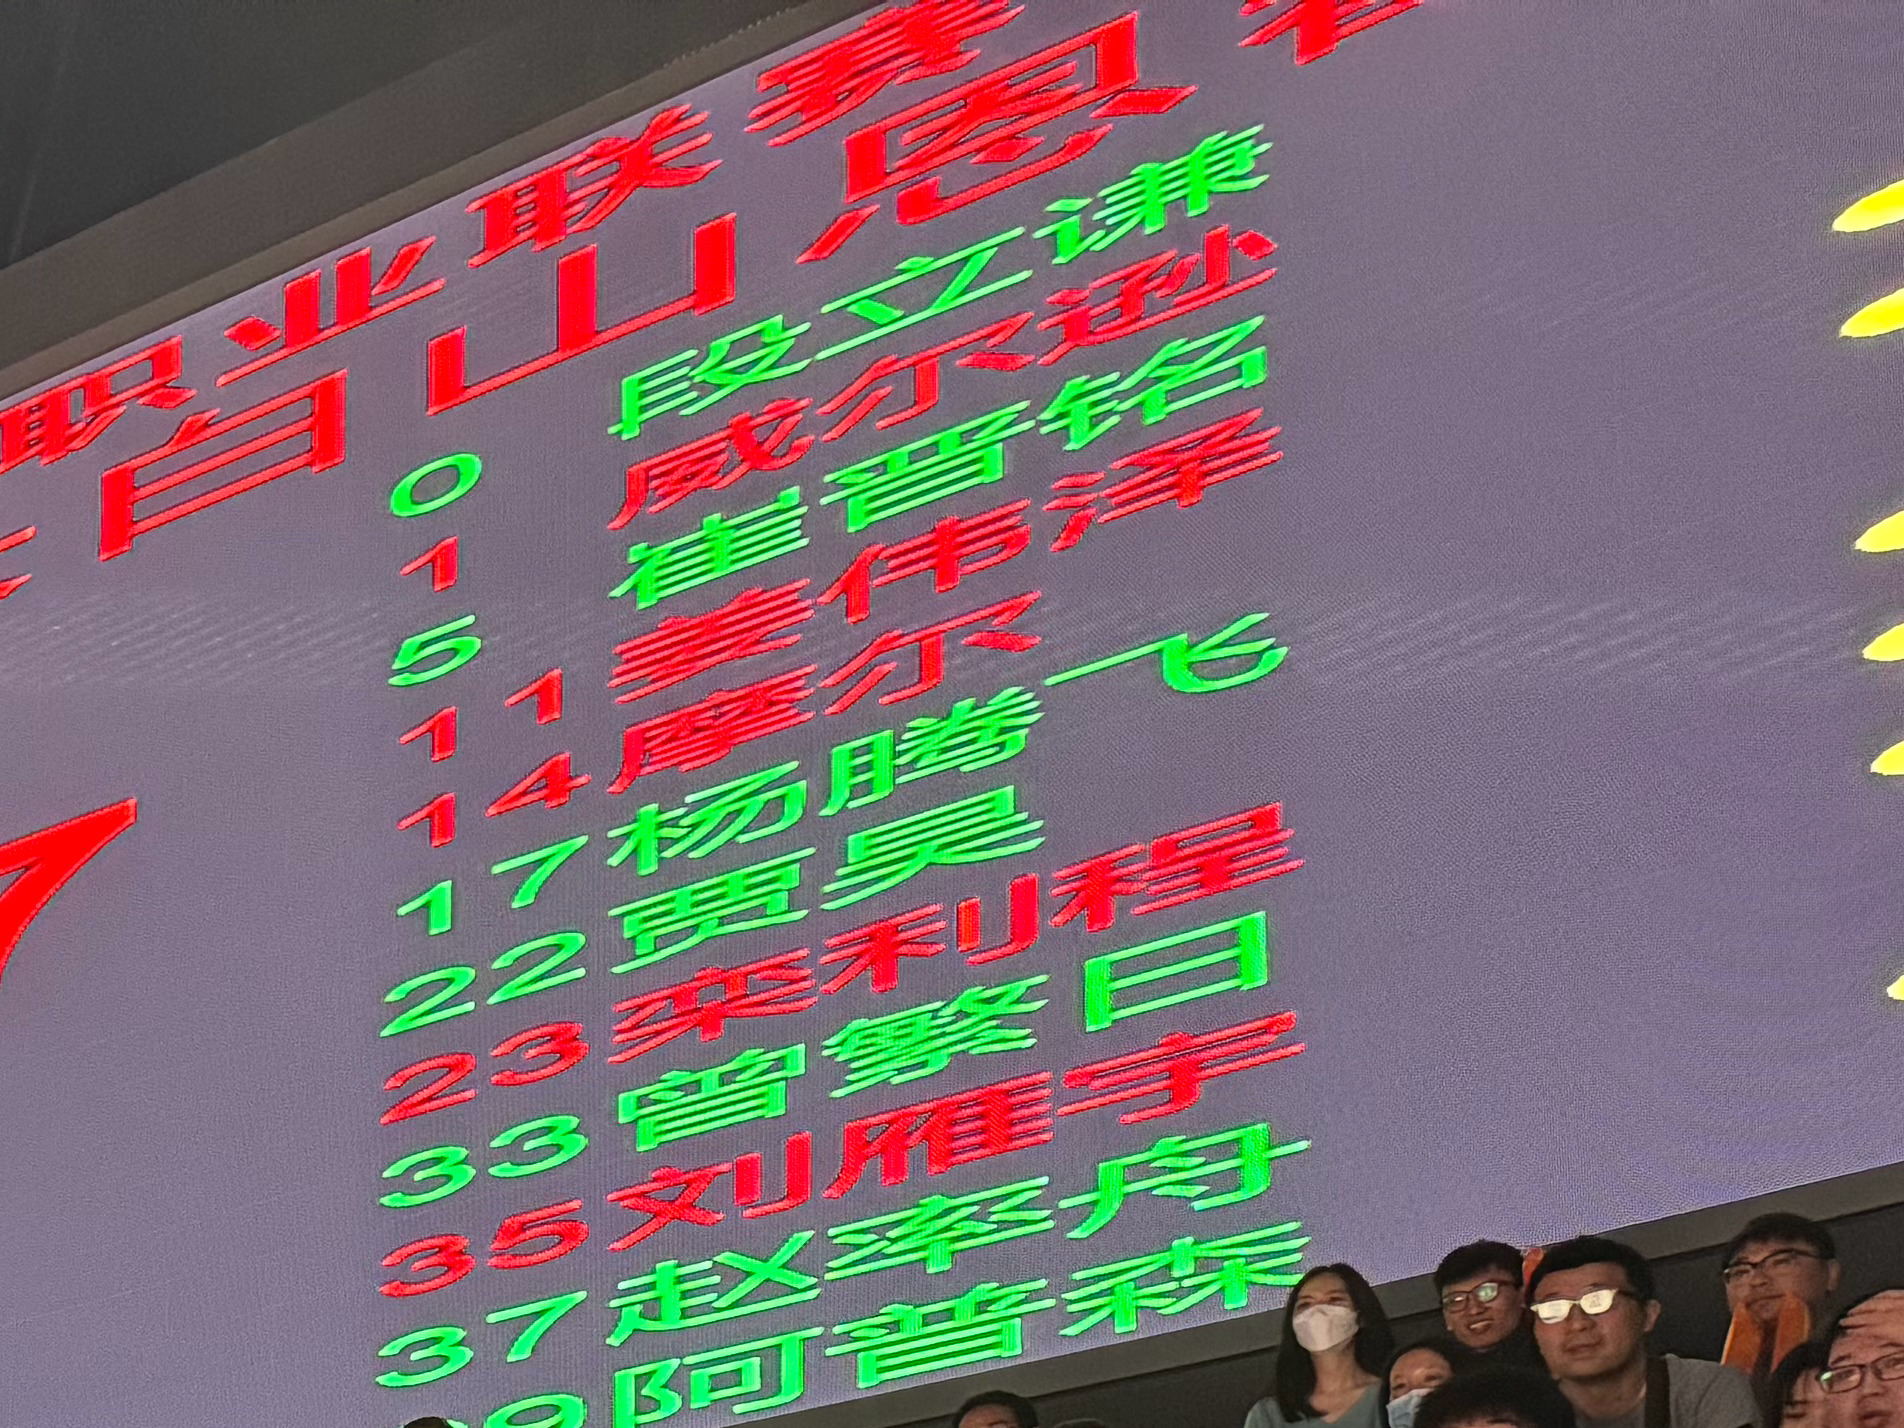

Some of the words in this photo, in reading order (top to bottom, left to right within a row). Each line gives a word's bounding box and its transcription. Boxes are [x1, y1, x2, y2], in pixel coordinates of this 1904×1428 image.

[388, 616, 481, 686] 5
[610, 316, 1268, 610] 崔晋铭
[390, 454, 482, 517] 0
[400, 536, 458, 592] 1
[608, 224, 1277, 530] 威尔逊
